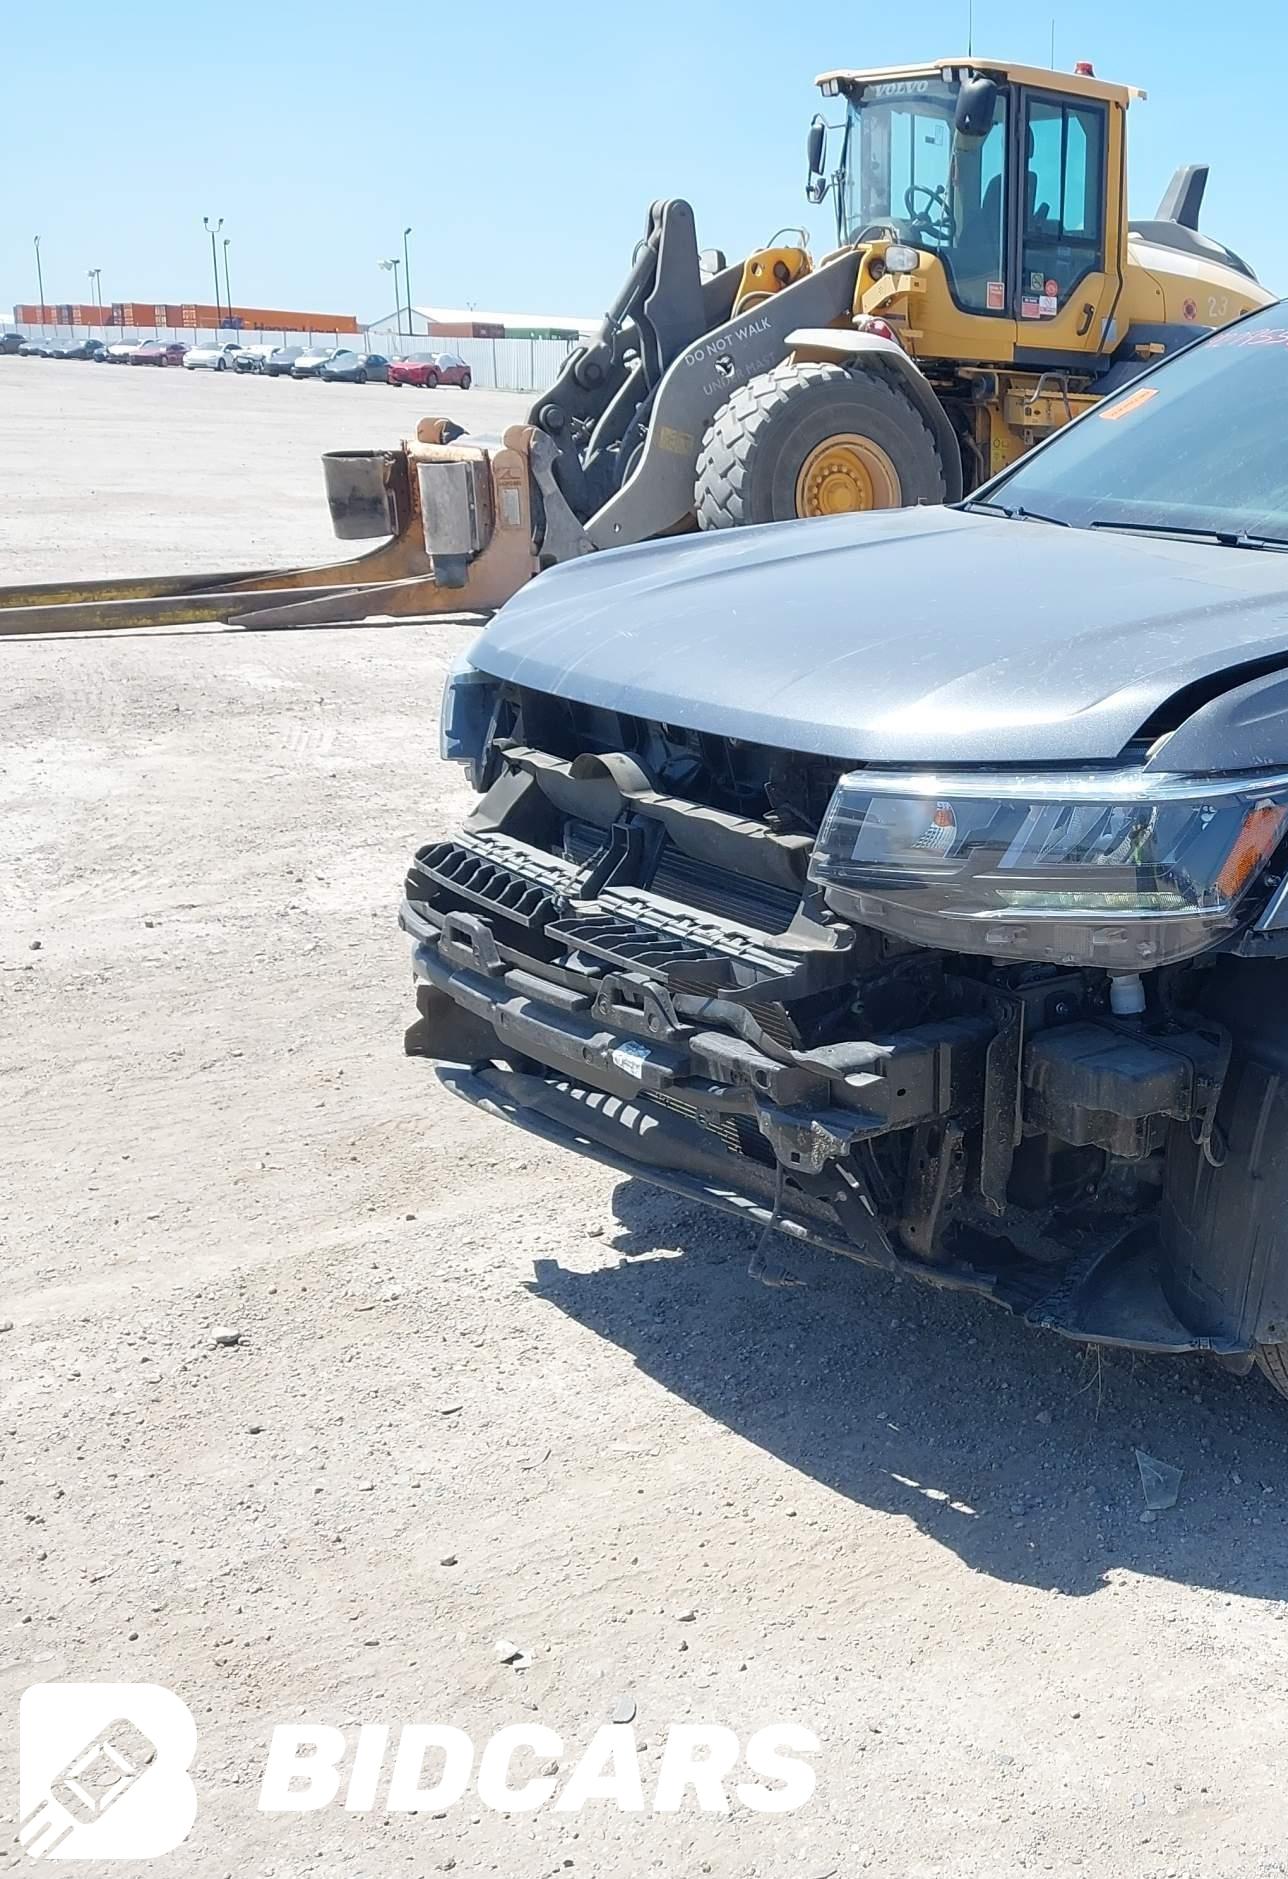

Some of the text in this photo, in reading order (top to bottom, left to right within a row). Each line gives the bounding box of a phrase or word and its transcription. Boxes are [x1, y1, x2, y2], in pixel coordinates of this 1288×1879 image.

[876, 80, 929, 97] VOLVO
[685, 316, 773, 367] DO NOT WALK
[703, 368, 745, 396] UNDR
